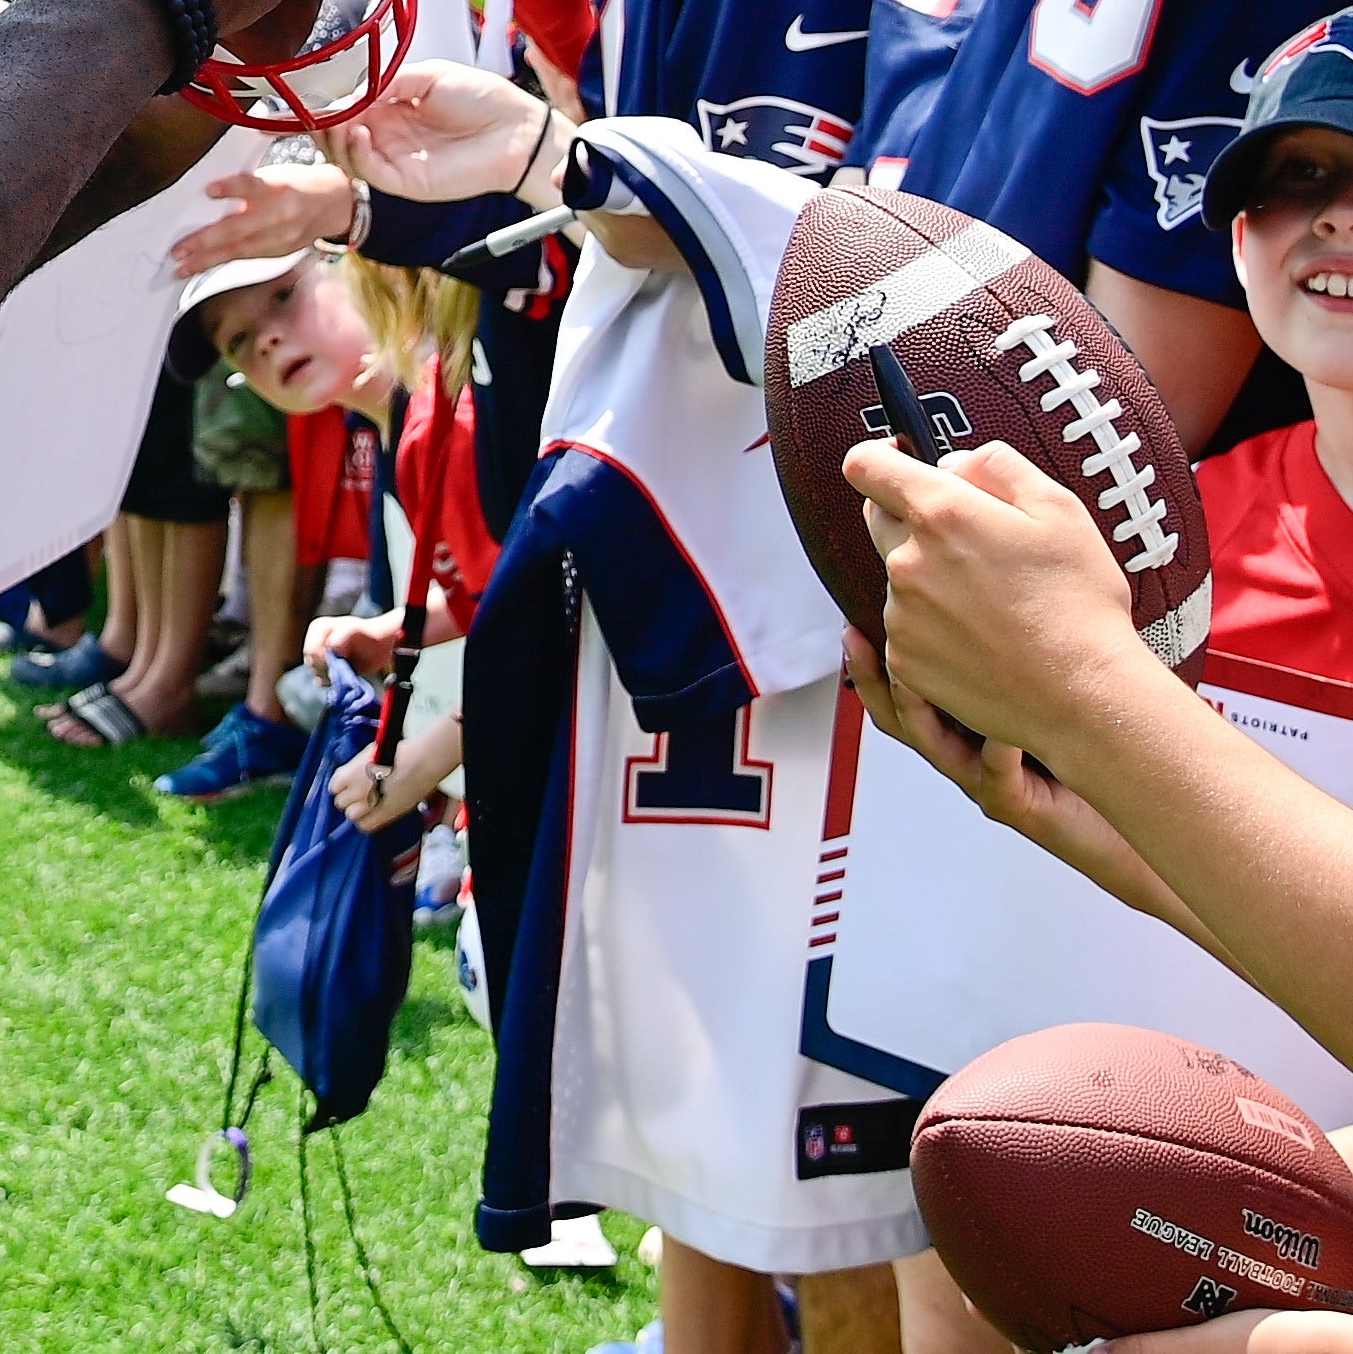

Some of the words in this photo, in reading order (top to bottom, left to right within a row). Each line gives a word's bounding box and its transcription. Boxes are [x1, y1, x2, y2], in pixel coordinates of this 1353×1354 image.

[1230, 711, 1309, 741] PATRIOTS
[1130, 1207, 1215, 1261] LEAGUE
[1241, 1208, 1322, 1271] Wilson
[1217, 1246, 1307, 1297] FOOTBALL
